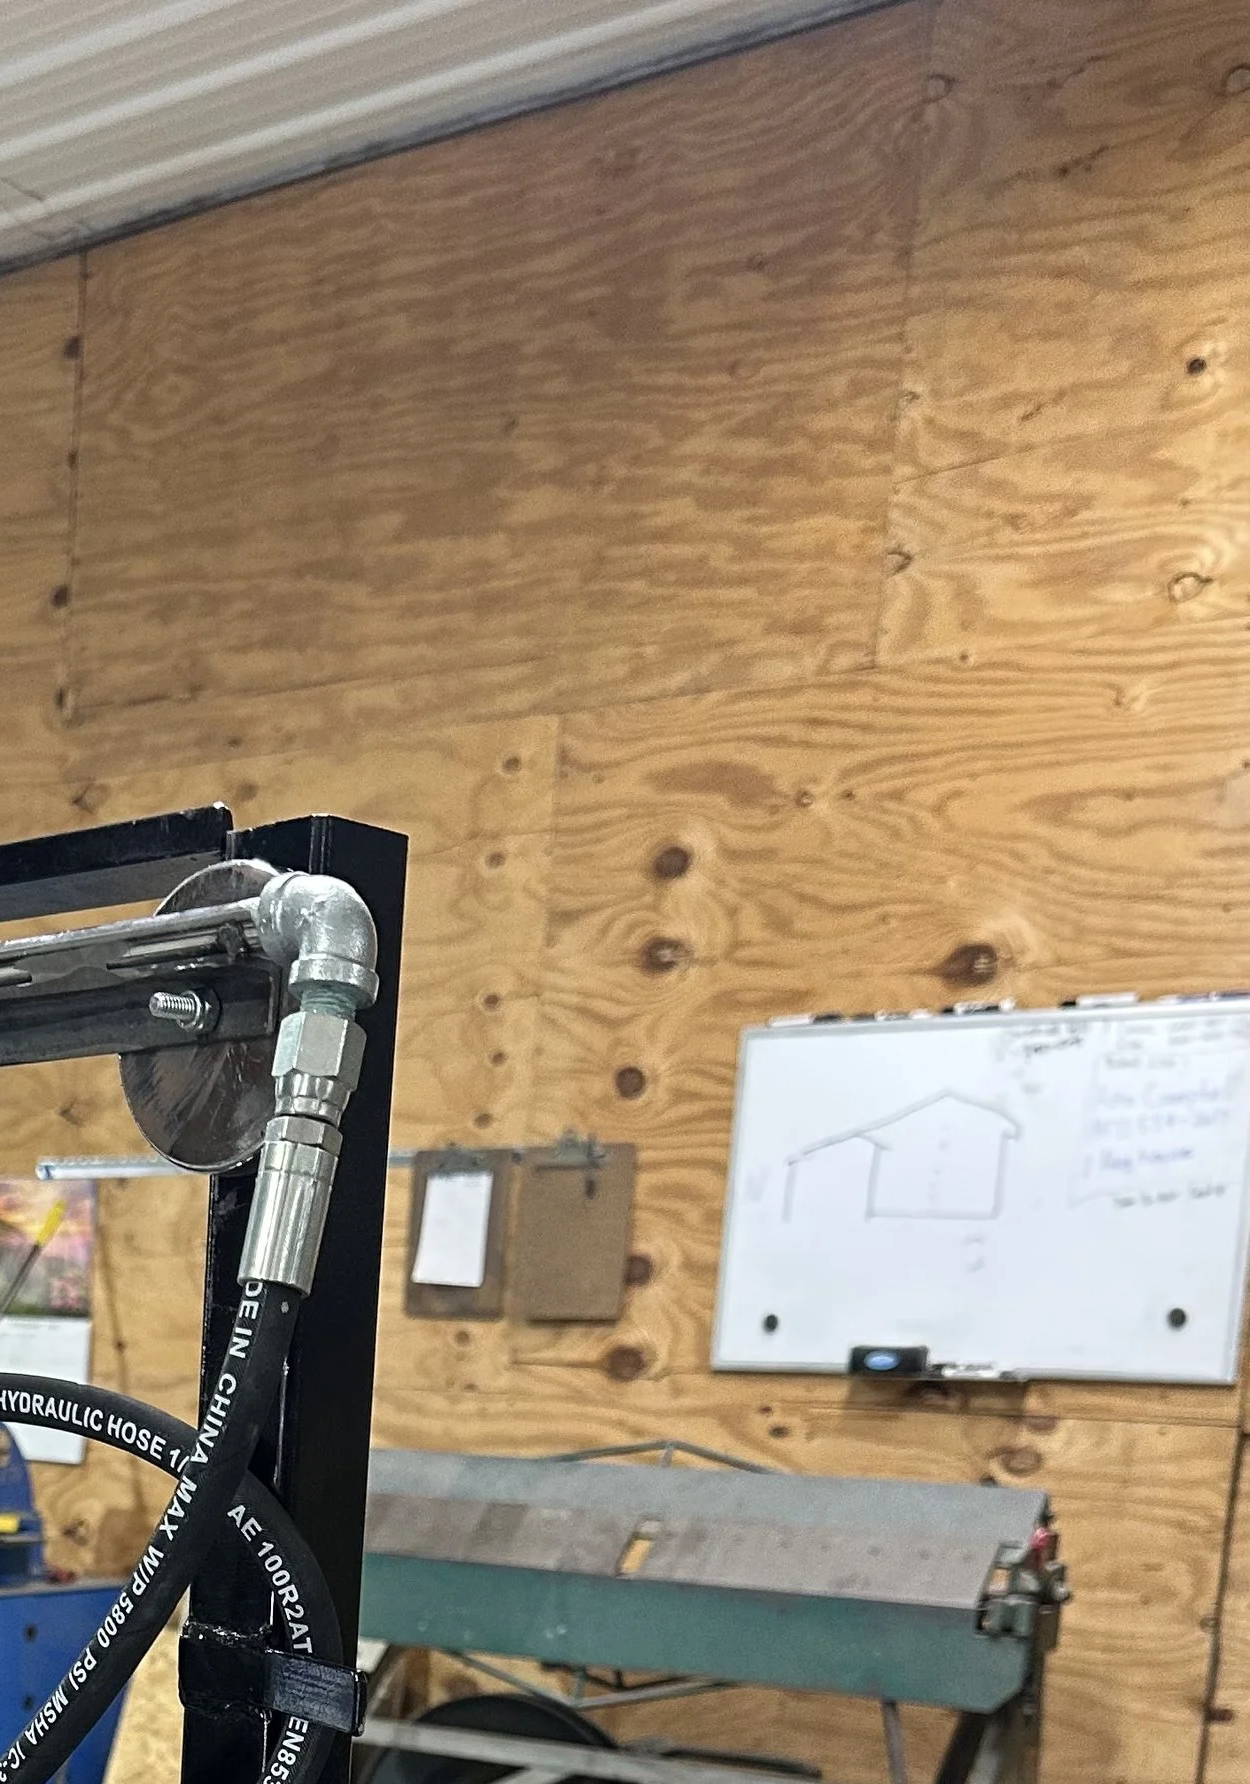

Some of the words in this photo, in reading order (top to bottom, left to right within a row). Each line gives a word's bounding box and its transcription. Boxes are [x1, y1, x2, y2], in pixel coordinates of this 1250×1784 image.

[238, 1281, 263, 1320] DE
[228, 1326, 253, 1359] IN
[190, 1373, 237, 1464] CHINA
[107, 1414, 167, 1460] HOSE
[169, 1449, 190, 1473] 1/
[227, 1504, 262, 1541] AE
[159, 1474, 198, 1541] MAX
[131, 1545, 164, 1597] W/P
[97, 1591, 134, 1648] 5800
[68, 1647, 98, 1691] PSI
[24, 1688, 69, 1745] MSHA
